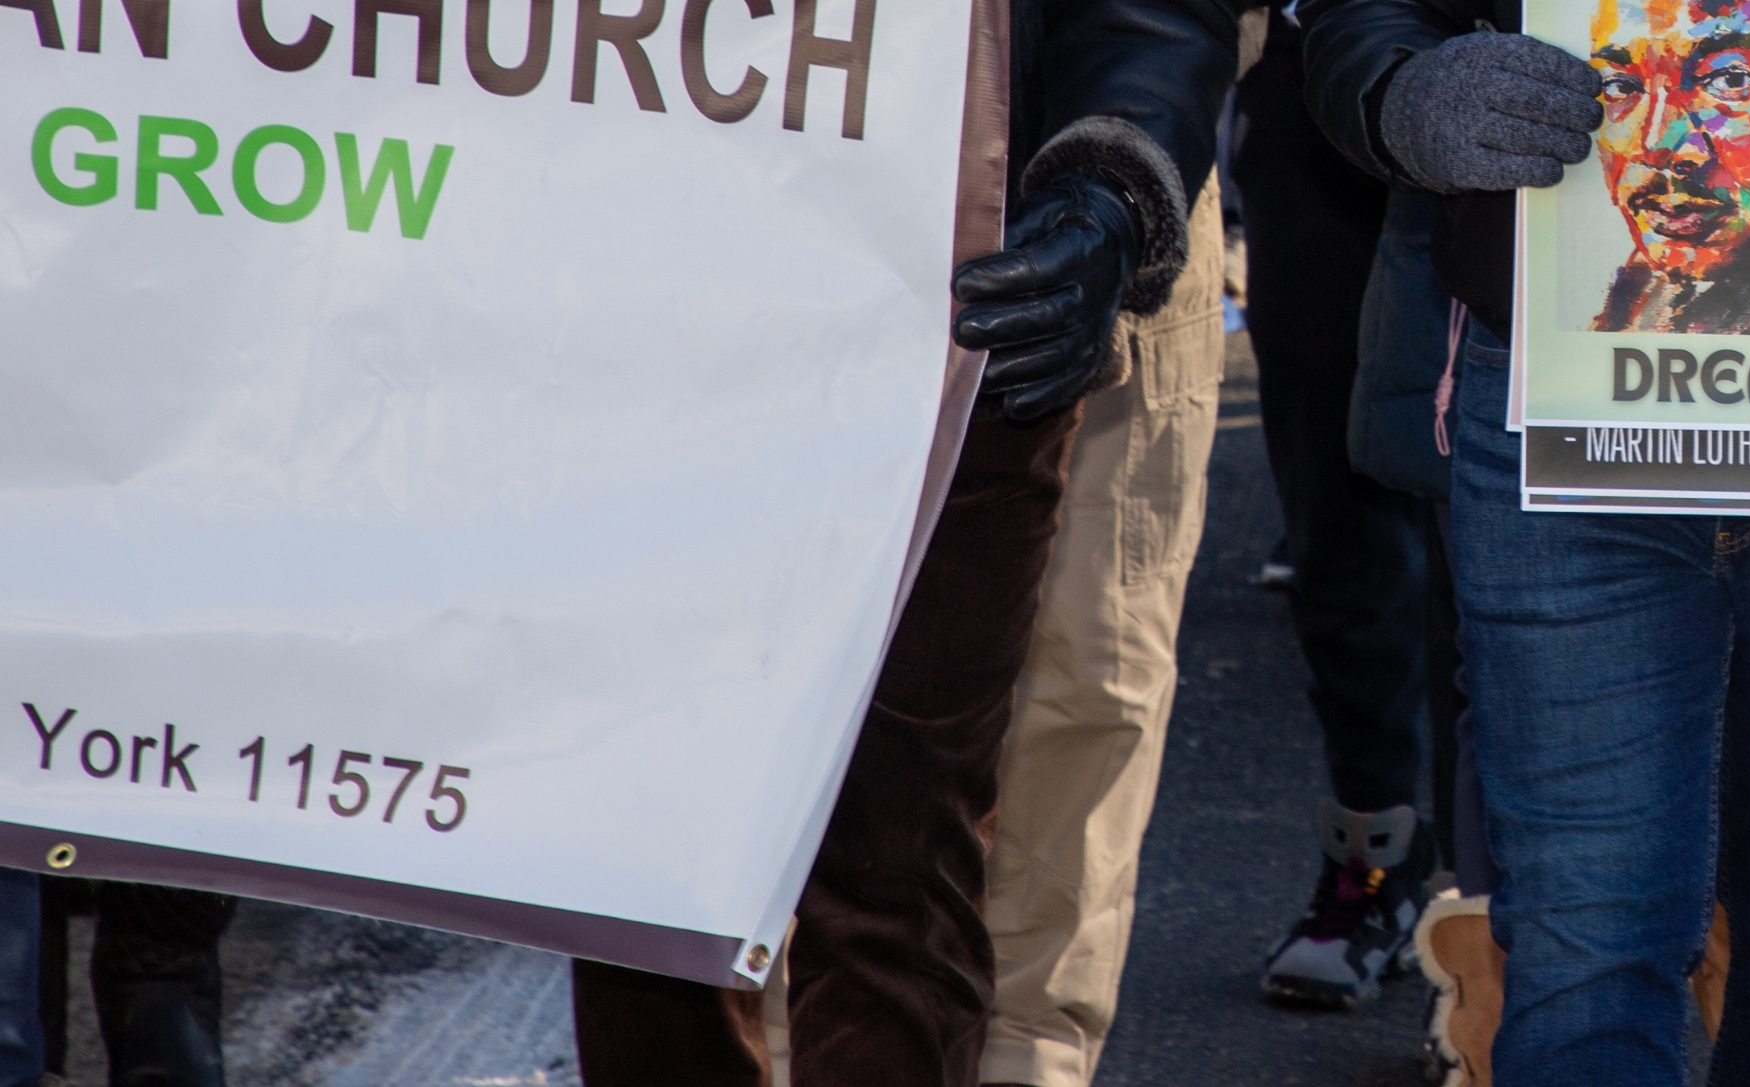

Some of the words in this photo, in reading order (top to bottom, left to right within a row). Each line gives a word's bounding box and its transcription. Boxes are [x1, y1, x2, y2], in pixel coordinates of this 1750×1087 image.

[31, 106, 456, 241] GROW
[1586, 427, 1683, 464] MARTIN
[21, 702, 200, 793] York
[238, 736, 472, 833] 11575
